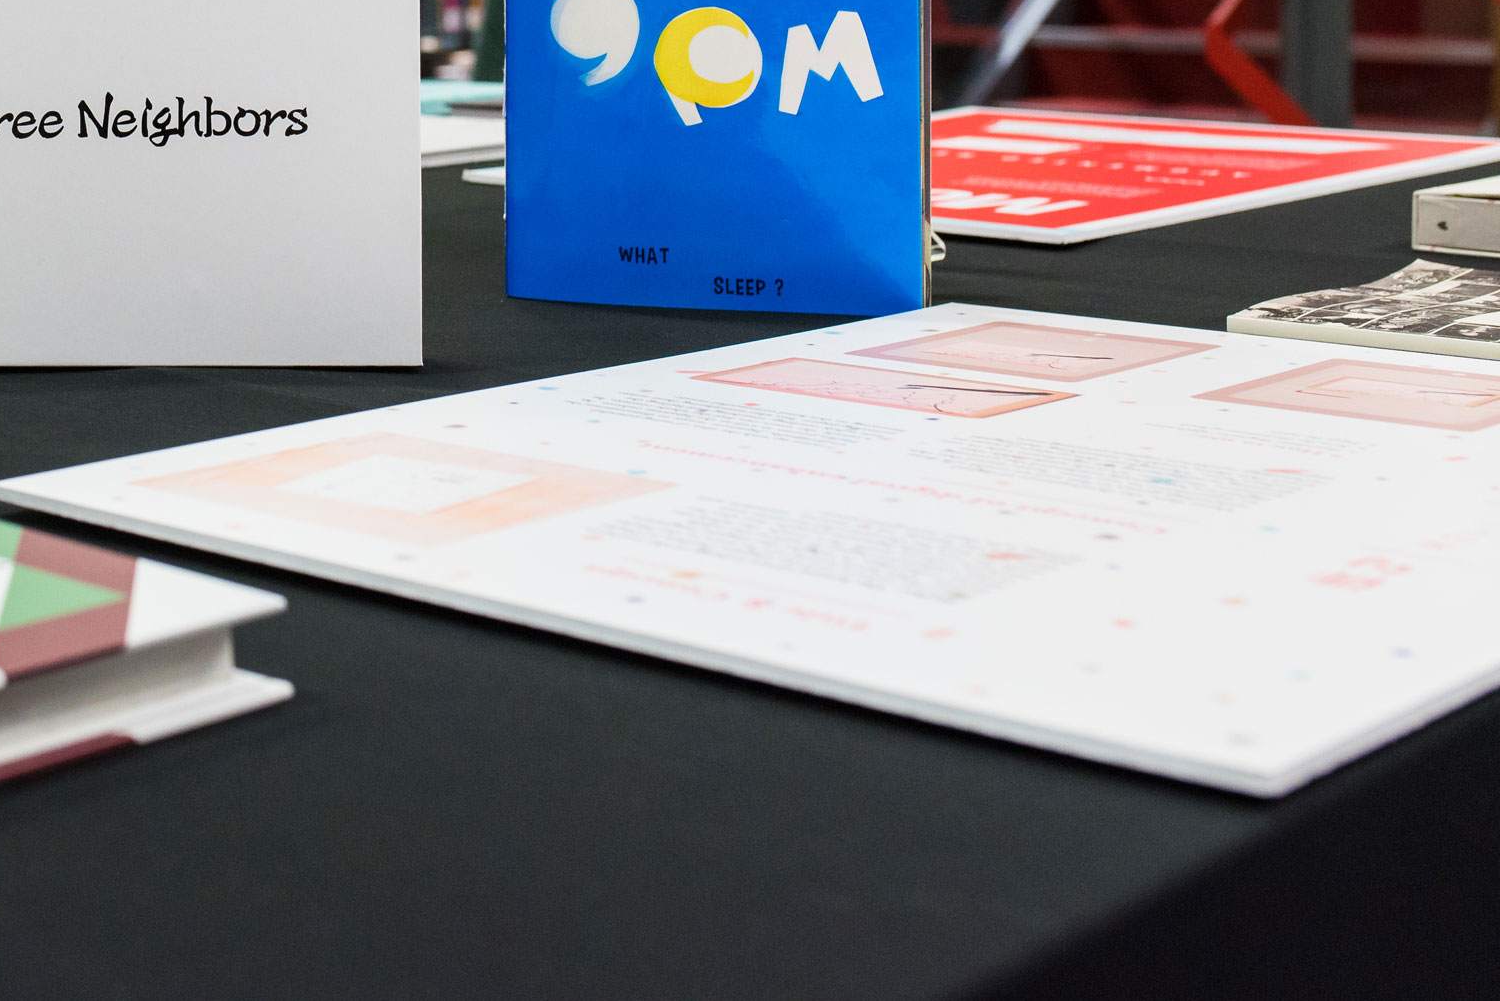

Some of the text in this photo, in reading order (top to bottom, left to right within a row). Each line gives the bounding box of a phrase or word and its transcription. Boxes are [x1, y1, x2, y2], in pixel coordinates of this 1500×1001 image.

[77, 92, 309, 147] Neighbors
[618, 246, 670, 265] WHAT
[713, 276, 766, 296] SLEEP
